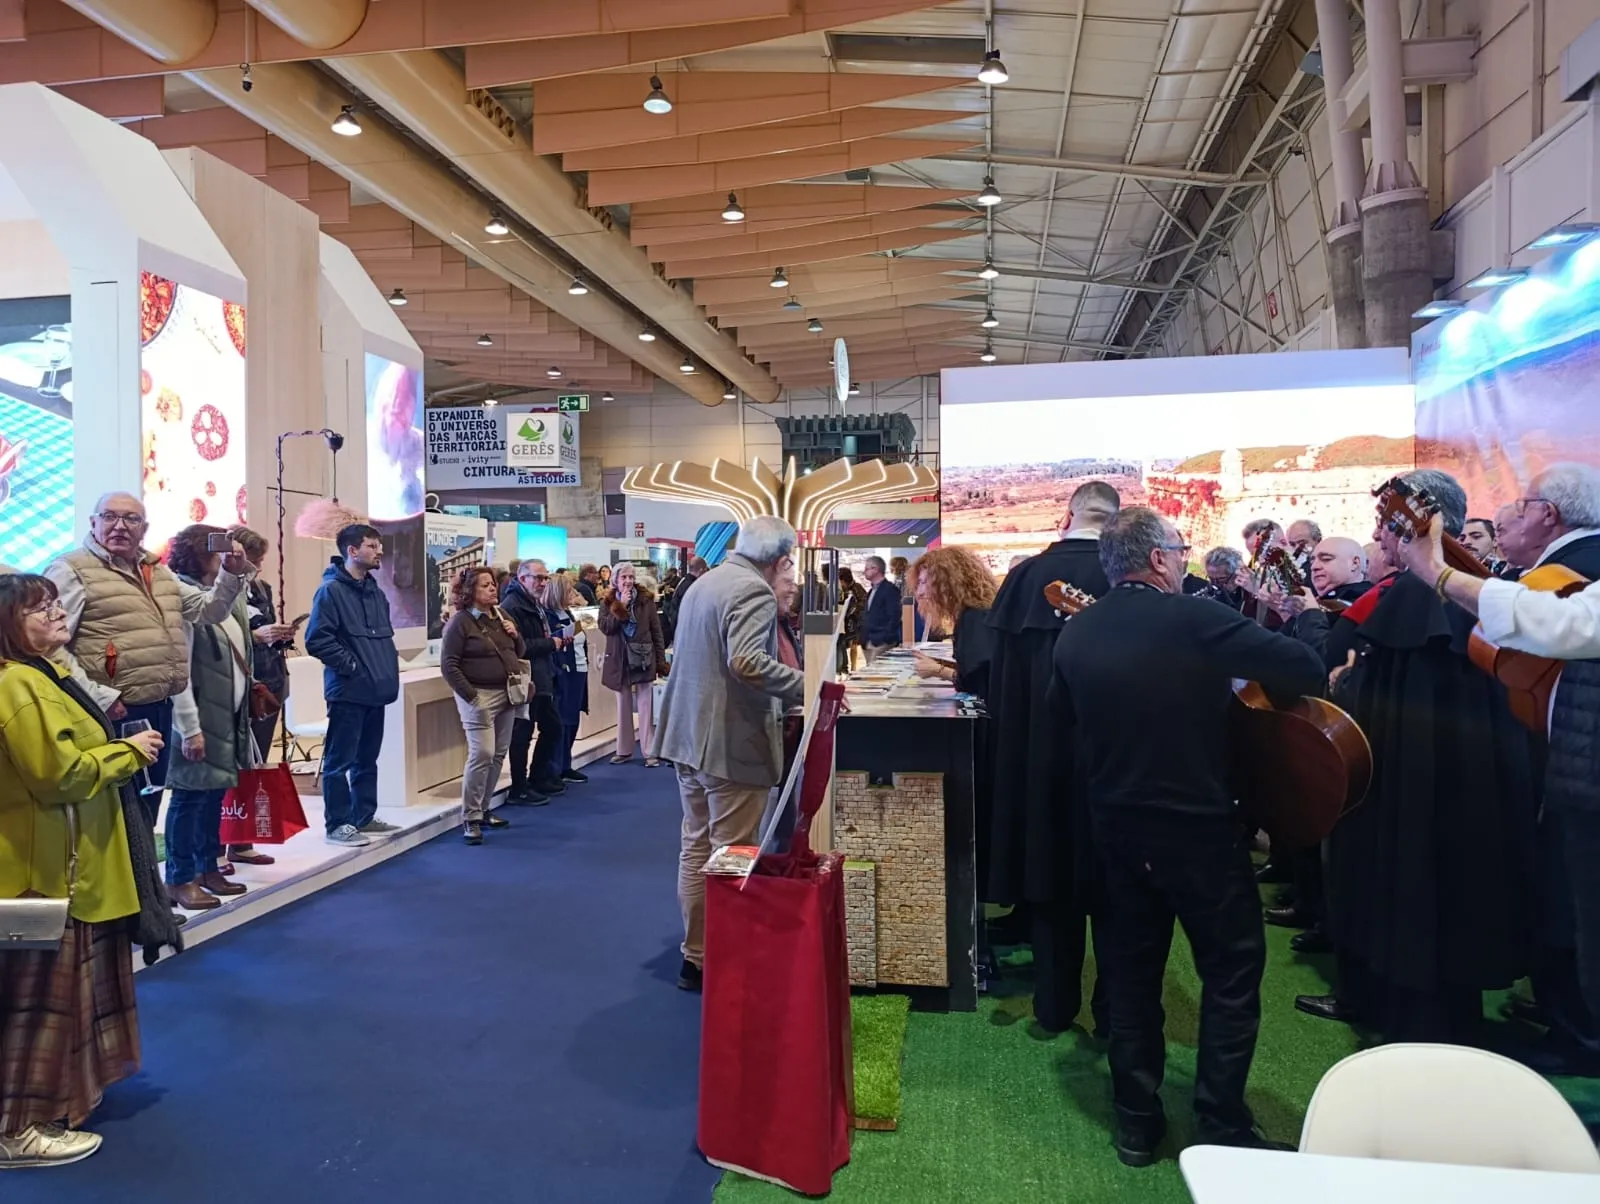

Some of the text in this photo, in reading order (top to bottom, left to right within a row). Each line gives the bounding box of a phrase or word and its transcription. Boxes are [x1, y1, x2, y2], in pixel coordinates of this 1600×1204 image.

[428, 410, 485, 422] EXPANDIR
[428, 420, 497, 432] O UNIVERSO
[429, 430, 498, 443] DAS MARCAS
[430, 440, 508, 453] TERRITORIAI
[511, 441, 555, 456] GERÊS
[463, 465, 516, 478] CINTURA
[518, 474, 577, 485] ASTEROIDES
